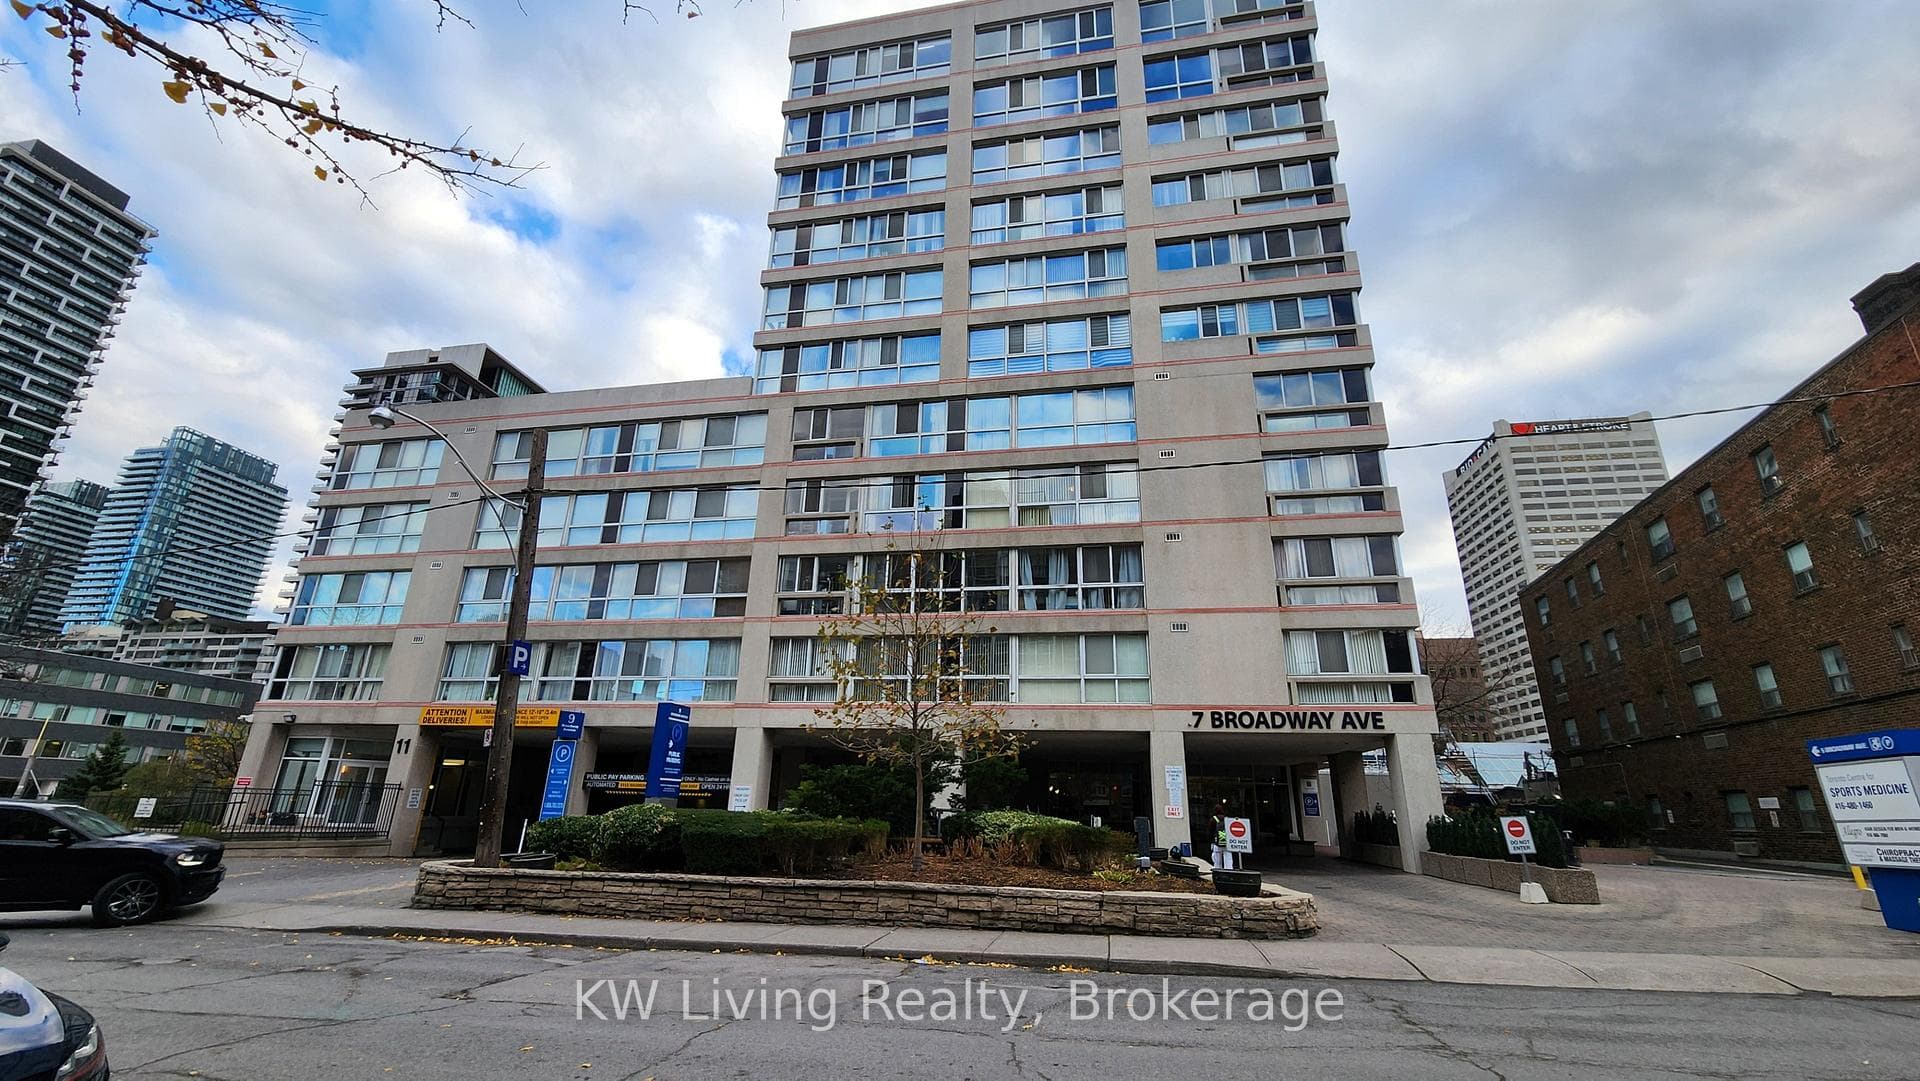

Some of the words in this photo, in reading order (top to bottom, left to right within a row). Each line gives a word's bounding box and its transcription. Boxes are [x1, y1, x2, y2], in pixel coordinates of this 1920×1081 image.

[1534, 422, 1573, 433] HEART
[513, 646, 528, 668] P
[426, 708, 467, 716] ATTENTION
[422, 716, 467, 724] DELIVERIES!
[567, 713, 576, 724] 9
[1210, 711, 1334, 730] BROADWAY
[1341, 711, 1386, 730] AVE
[397, 738, 411, 754] 11
[560, 748, 568, 758] P
[1829, 785, 1863, 798] SPORTS
[1863, 783, 1909, 796] MEDICINE
